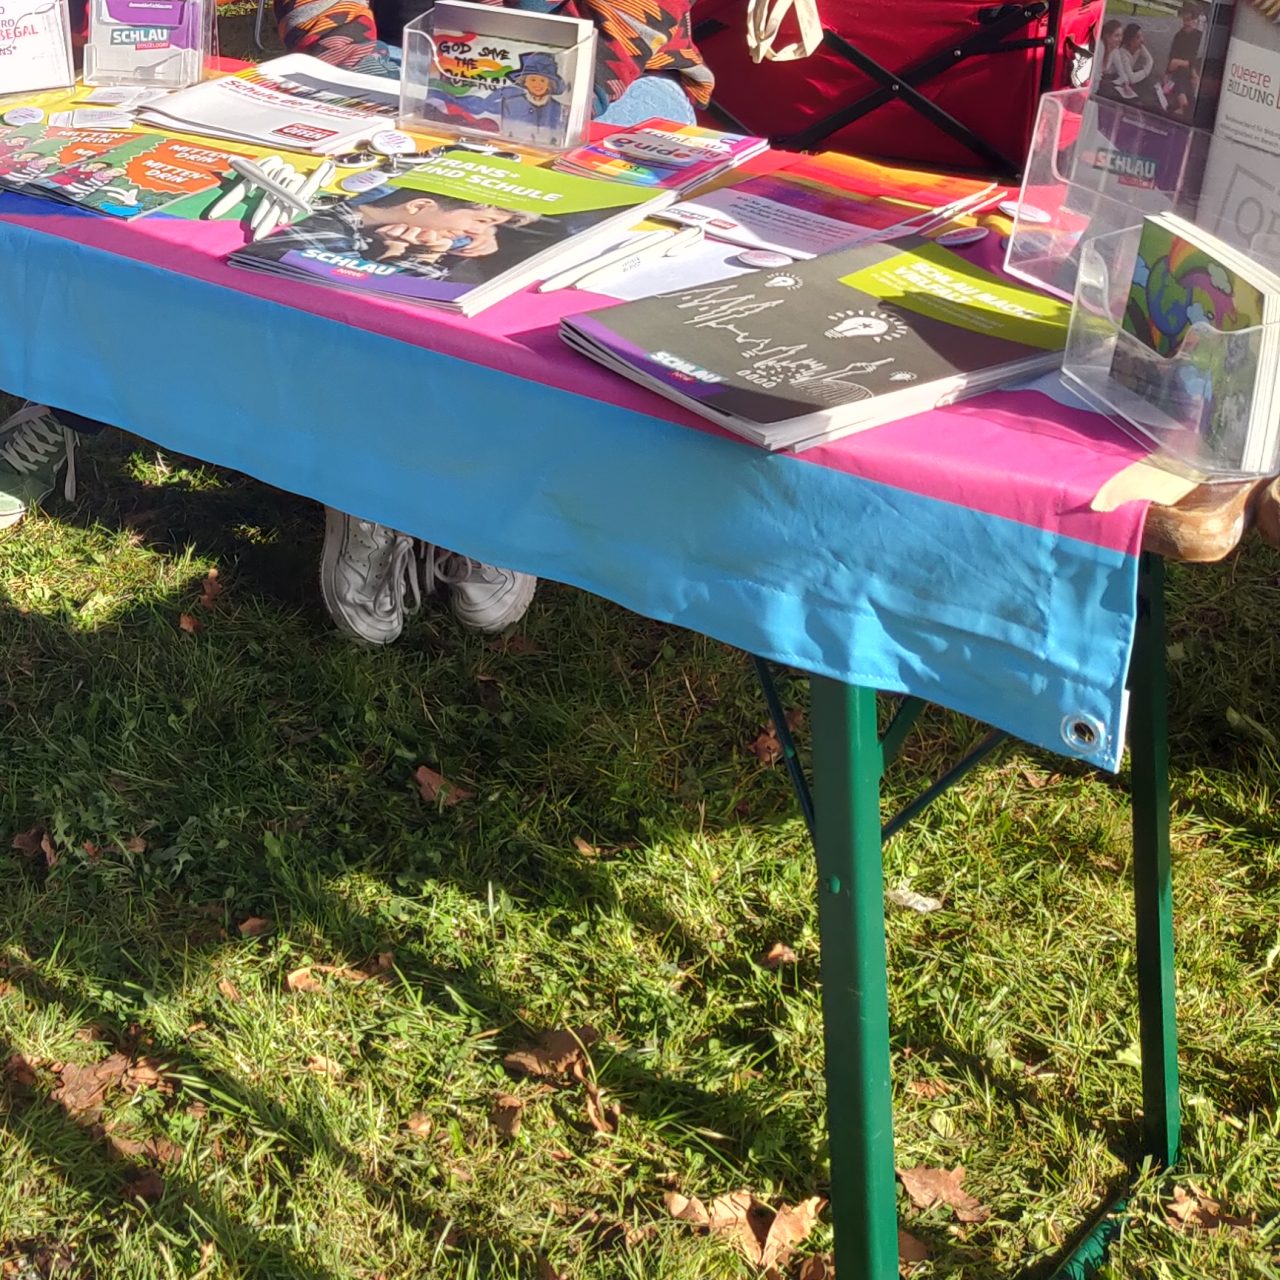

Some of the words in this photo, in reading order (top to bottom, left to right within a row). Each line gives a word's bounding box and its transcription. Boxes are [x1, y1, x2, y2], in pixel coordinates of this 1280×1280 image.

[112, 28, 168, 44] SCHLAU
[439, 41, 472, 55] GOD
[477, 46, 512, 61] SAVE
[454, 56, 478, 71] THE
[1231, 63, 1272, 88] queere
[225, 80, 280, 102] Schule
[280, 95, 312, 108] der
[1227, 79, 1275, 106] BILDUNG
[175, 152, 219, 164] DRIN
[611, 136, 691, 159] guide
[141, 159, 213, 181] MITTEN-
[1096, 150, 1156, 178] SCHLAU
[145, 168, 190, 184] DRIN
[414, 165, 467, 178] UND
[465, 175, 564, 202] SCHULE
[301, 249, 396, 275] SCHLAU
